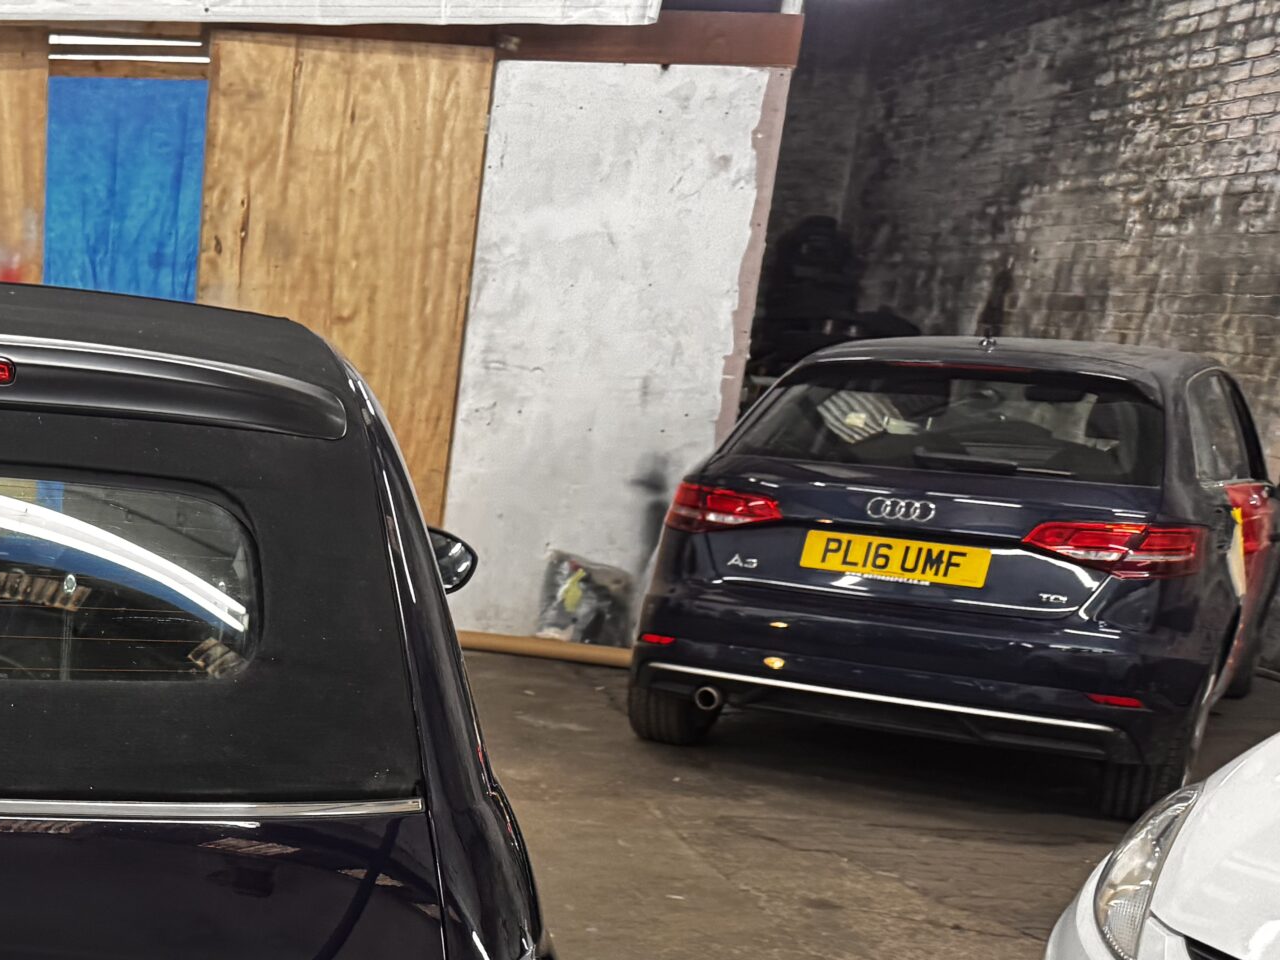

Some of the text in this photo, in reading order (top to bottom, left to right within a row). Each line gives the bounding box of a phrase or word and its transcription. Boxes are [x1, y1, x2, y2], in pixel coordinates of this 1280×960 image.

[727, 553, 758, 569] A3
[821, 537, 968, 578] PL16 UMF
